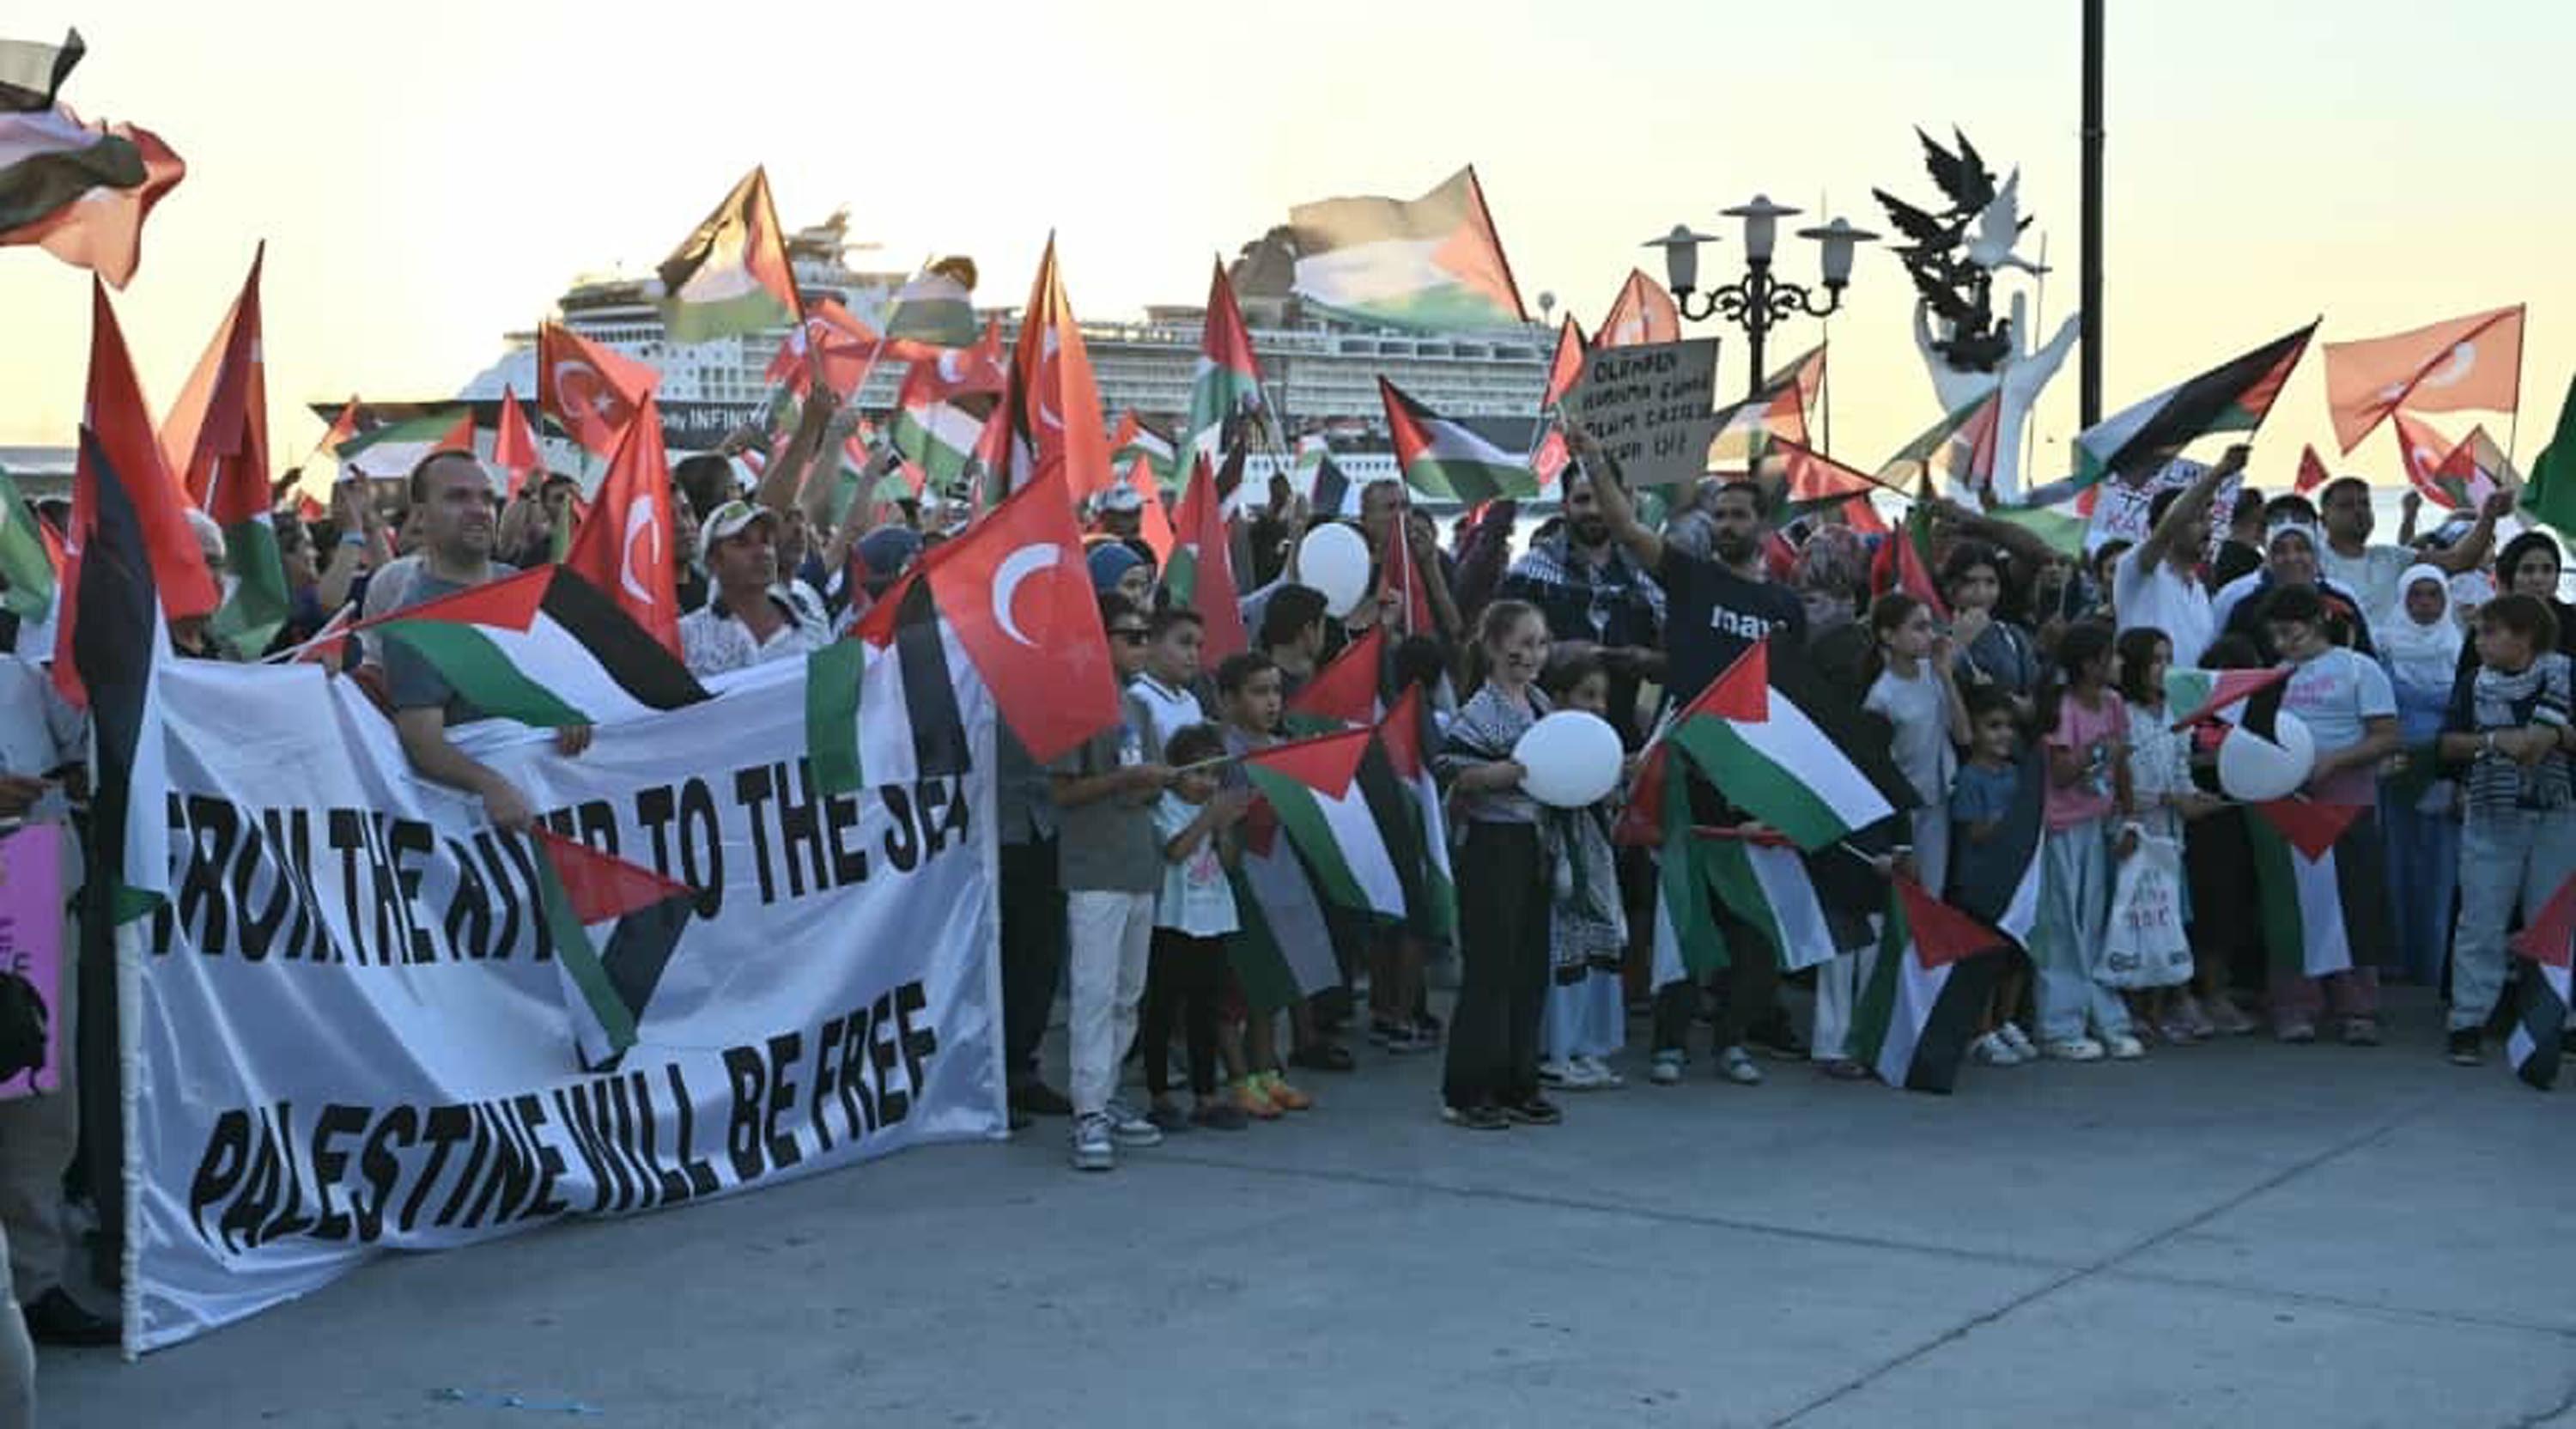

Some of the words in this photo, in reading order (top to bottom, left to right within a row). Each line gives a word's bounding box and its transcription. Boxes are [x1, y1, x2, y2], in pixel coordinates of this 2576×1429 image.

[152, 790, 344, 963] FROM
[327, 807, 435, 967] THE
[636, 776, 724, 921] TO
[735, 757, 869, 904] THE
[190, 1100, 570, 1255] PALESTINE
[555, 1063, 720, 1213] WILL
[722, 1032, 803, 1182] BE
